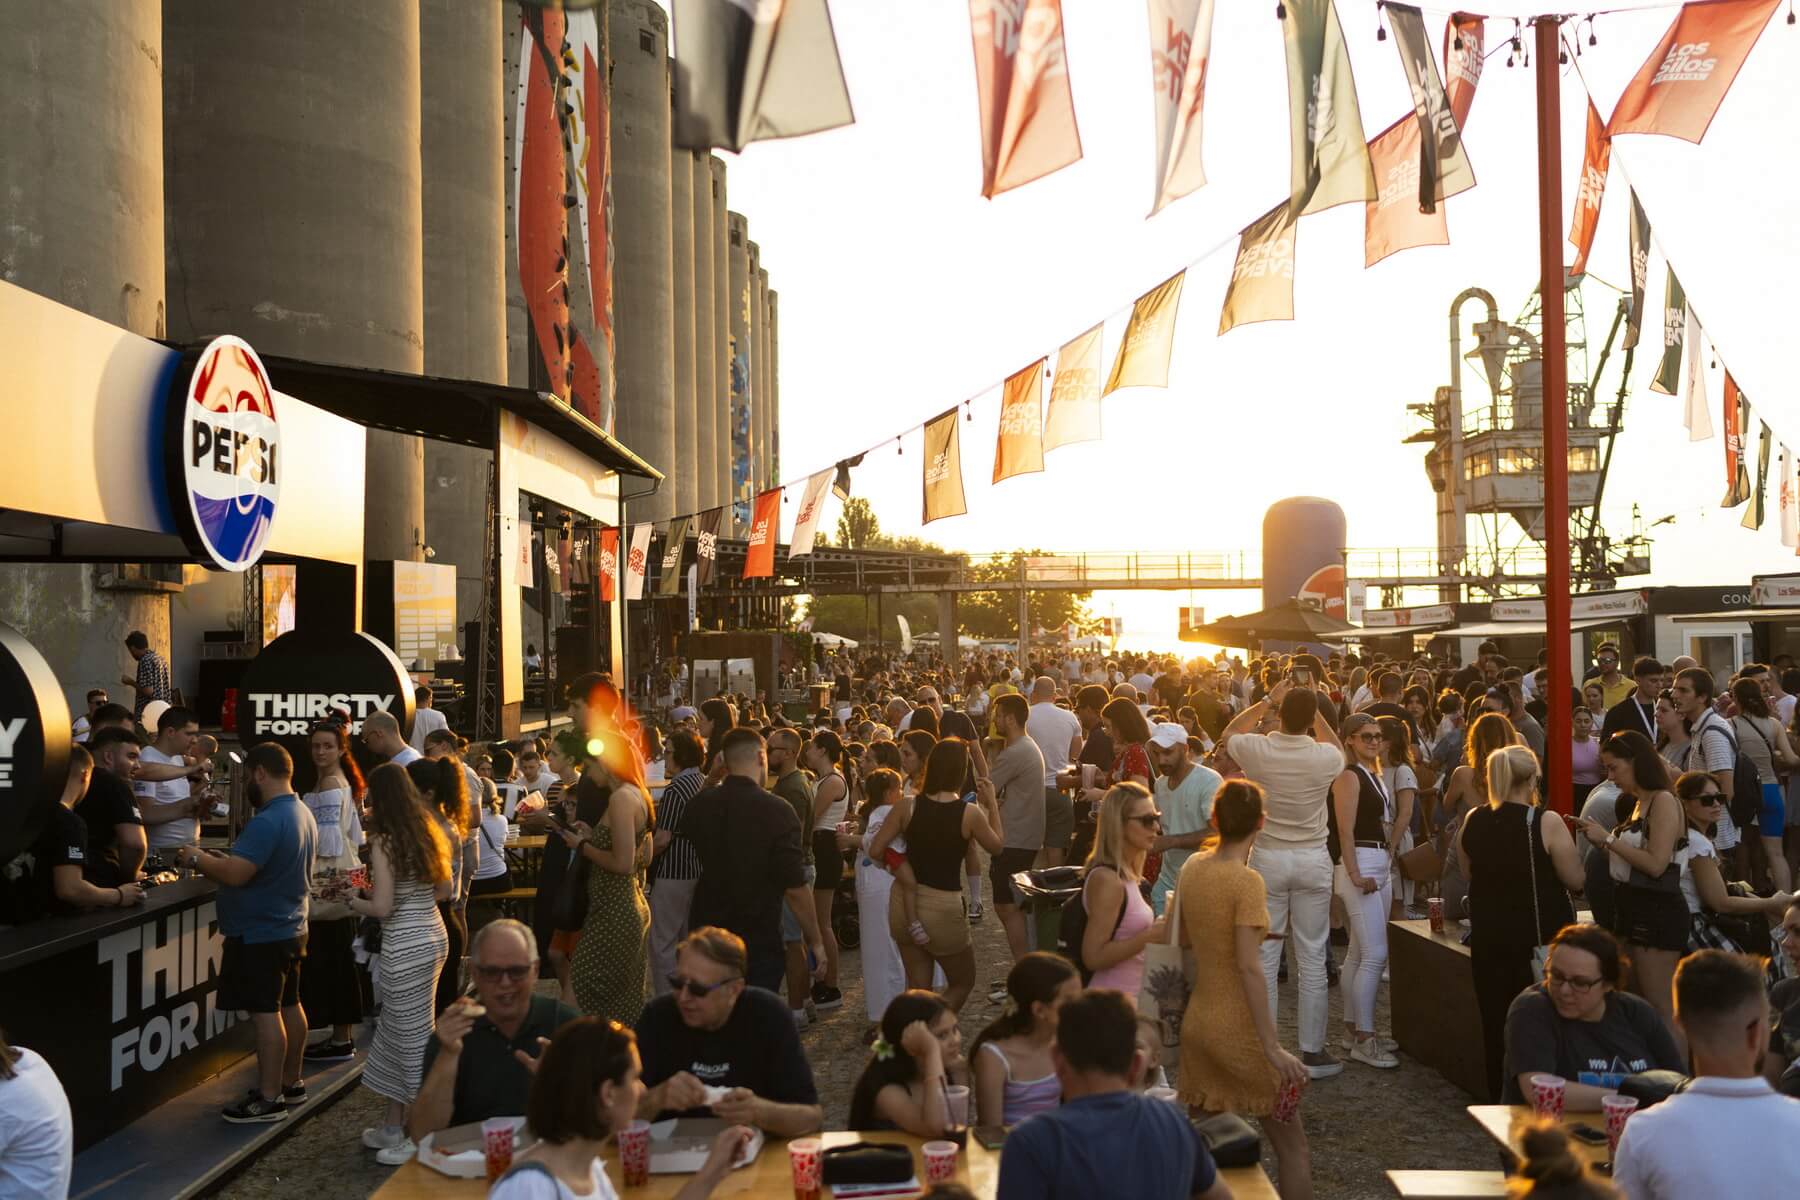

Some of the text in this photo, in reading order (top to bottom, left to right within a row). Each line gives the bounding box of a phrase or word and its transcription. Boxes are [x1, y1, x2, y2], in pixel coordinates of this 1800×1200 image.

[192, 419, 276, 485] PEPSI
[248, 693, 396, 718] THIRSTY
[256, 720, 309, 736] FOR
[98, 901, 226, 1024] THIR
[112, 1001, 199, 1091] FOR
